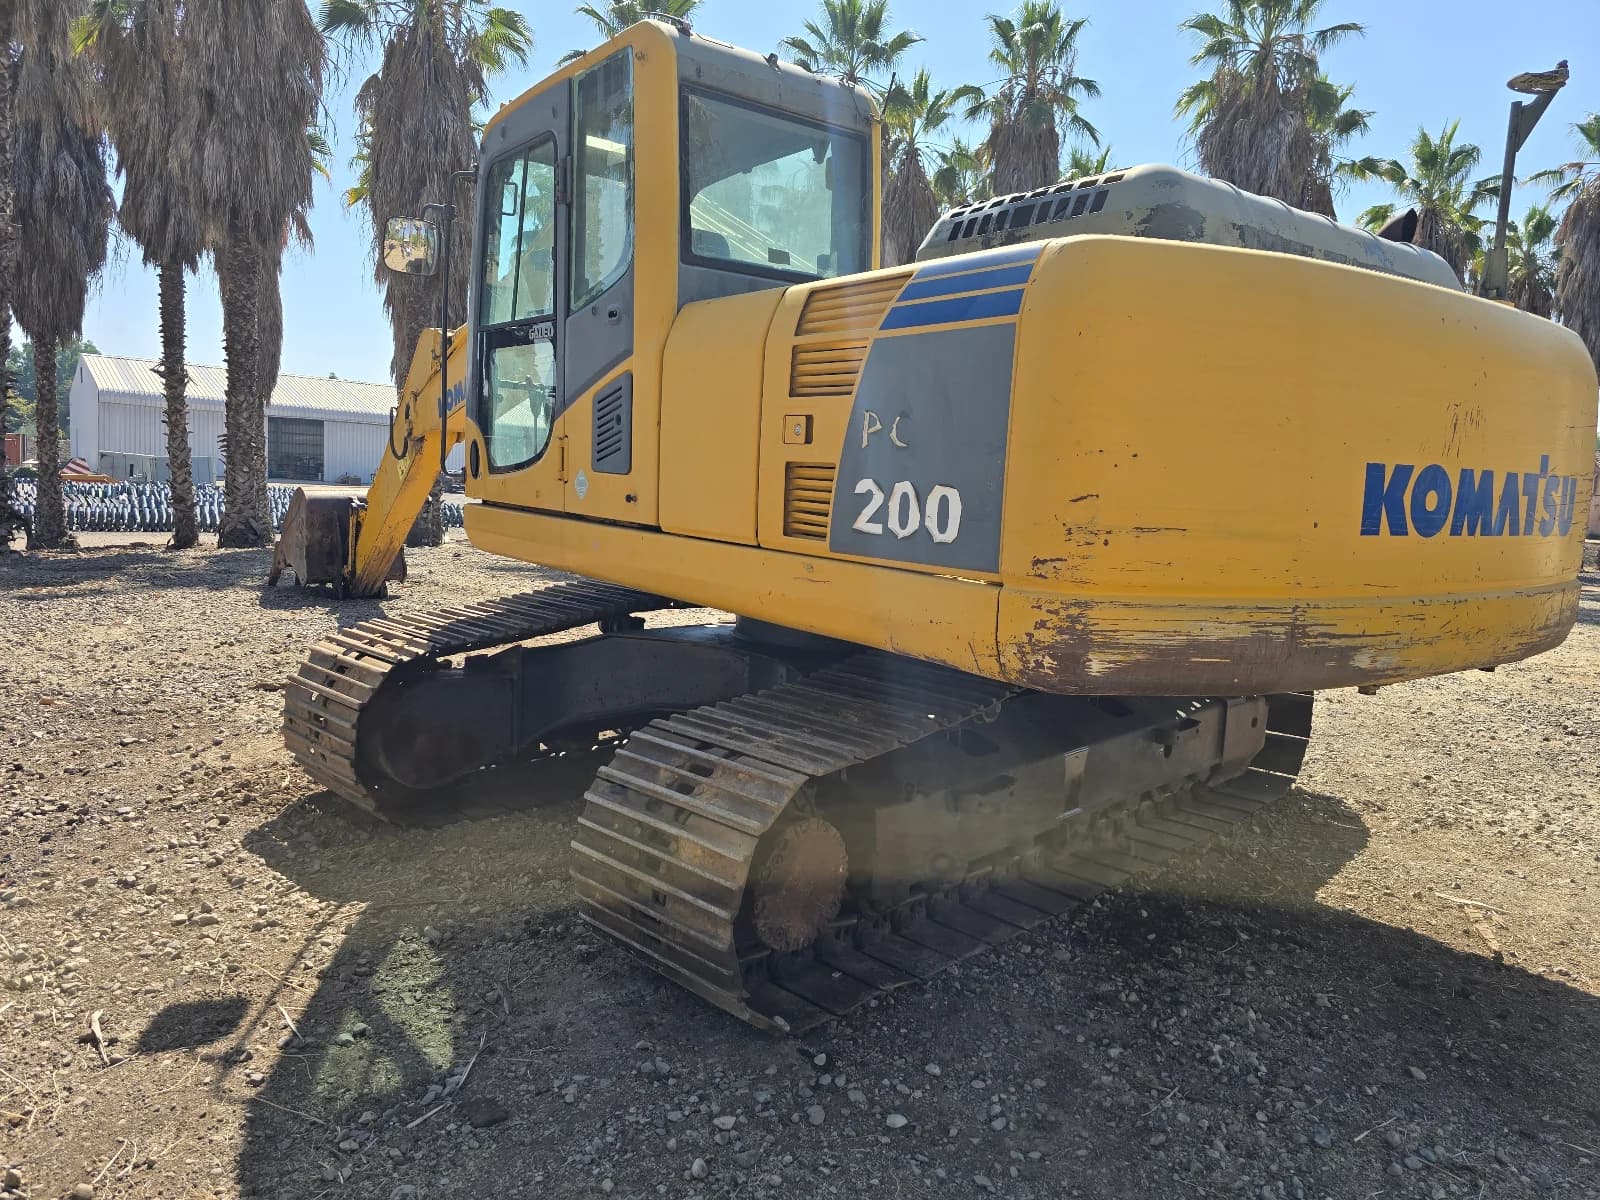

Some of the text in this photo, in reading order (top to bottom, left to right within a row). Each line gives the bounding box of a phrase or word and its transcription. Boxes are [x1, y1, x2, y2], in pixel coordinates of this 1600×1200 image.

[861, 411, 909, 449] PC
[852, 478, 962, 544] 200
[1360, 455, 1577, 538] KOMATSU
